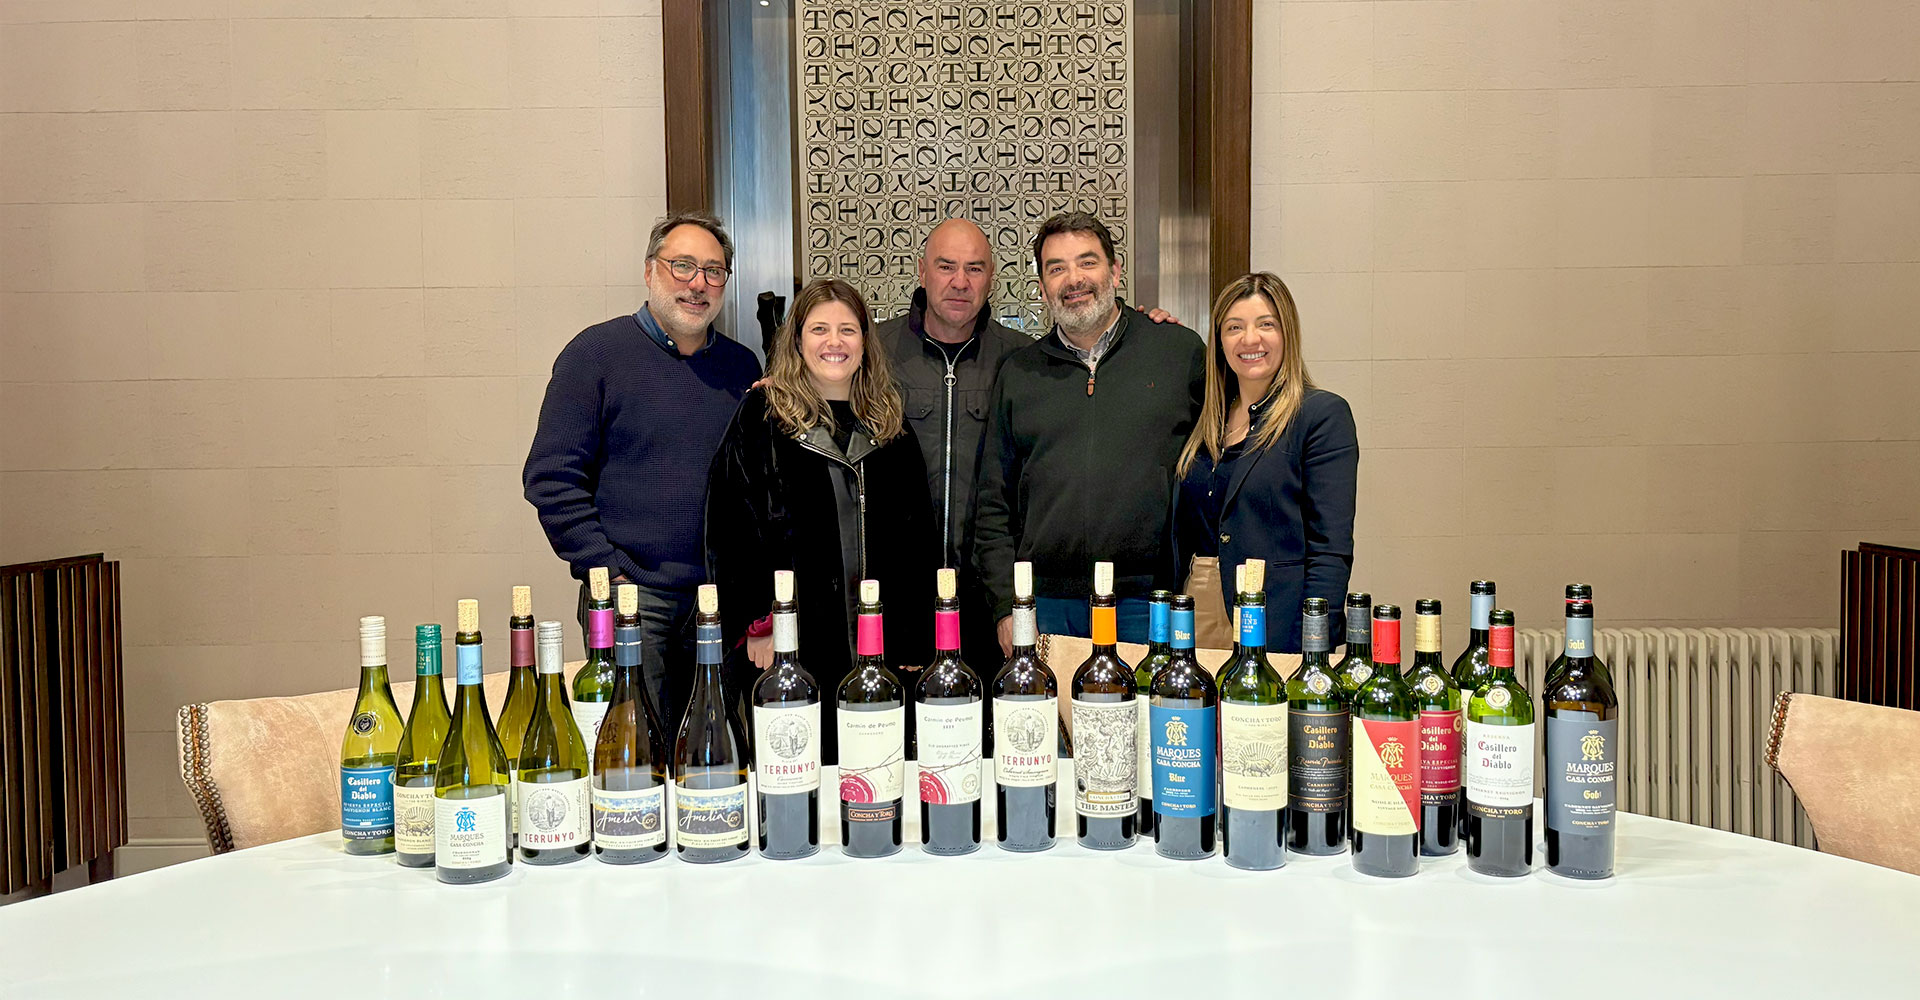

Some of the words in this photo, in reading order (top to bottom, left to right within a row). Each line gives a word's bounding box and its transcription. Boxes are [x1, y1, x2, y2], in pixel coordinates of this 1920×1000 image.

[1174, 630, 1190, 640] Blue
[1568, 639, 1585, 650] Gold
[1304, 725, 1337, 734] Casillero
[1421, 726, 1452, 735] asillero
[1308, 740, 1334, 749] Diablo
[1478, 741, 1517, 753] Casillero
[1156, 746, 1201, 760] MARQUES
[1002, 754, 1051, 766] TERRUNYO
[1482, 758, 1512, 770] Diablo
[764, 761, 815, 775] TERRUNYO
[1567, 762, 1614, 776] MARQUES
[348, 777, 381, 786] Casillero
[1168, 773, 1186, 782] Blue
[1371, 773, 1413, 784] MARQUES
[1586, 776, 1614, 784] CONCHA
[352, 791, 376, 799] Diablo
[1080, 803, 1098, 811] THE
[1099, 801, 1134, 811] MASTER
[1472, 805, 1499, 814] CONCHA
[450, 833, 484, 842] MARQUES
[524, 832, 574, 843] TERRUNYO
